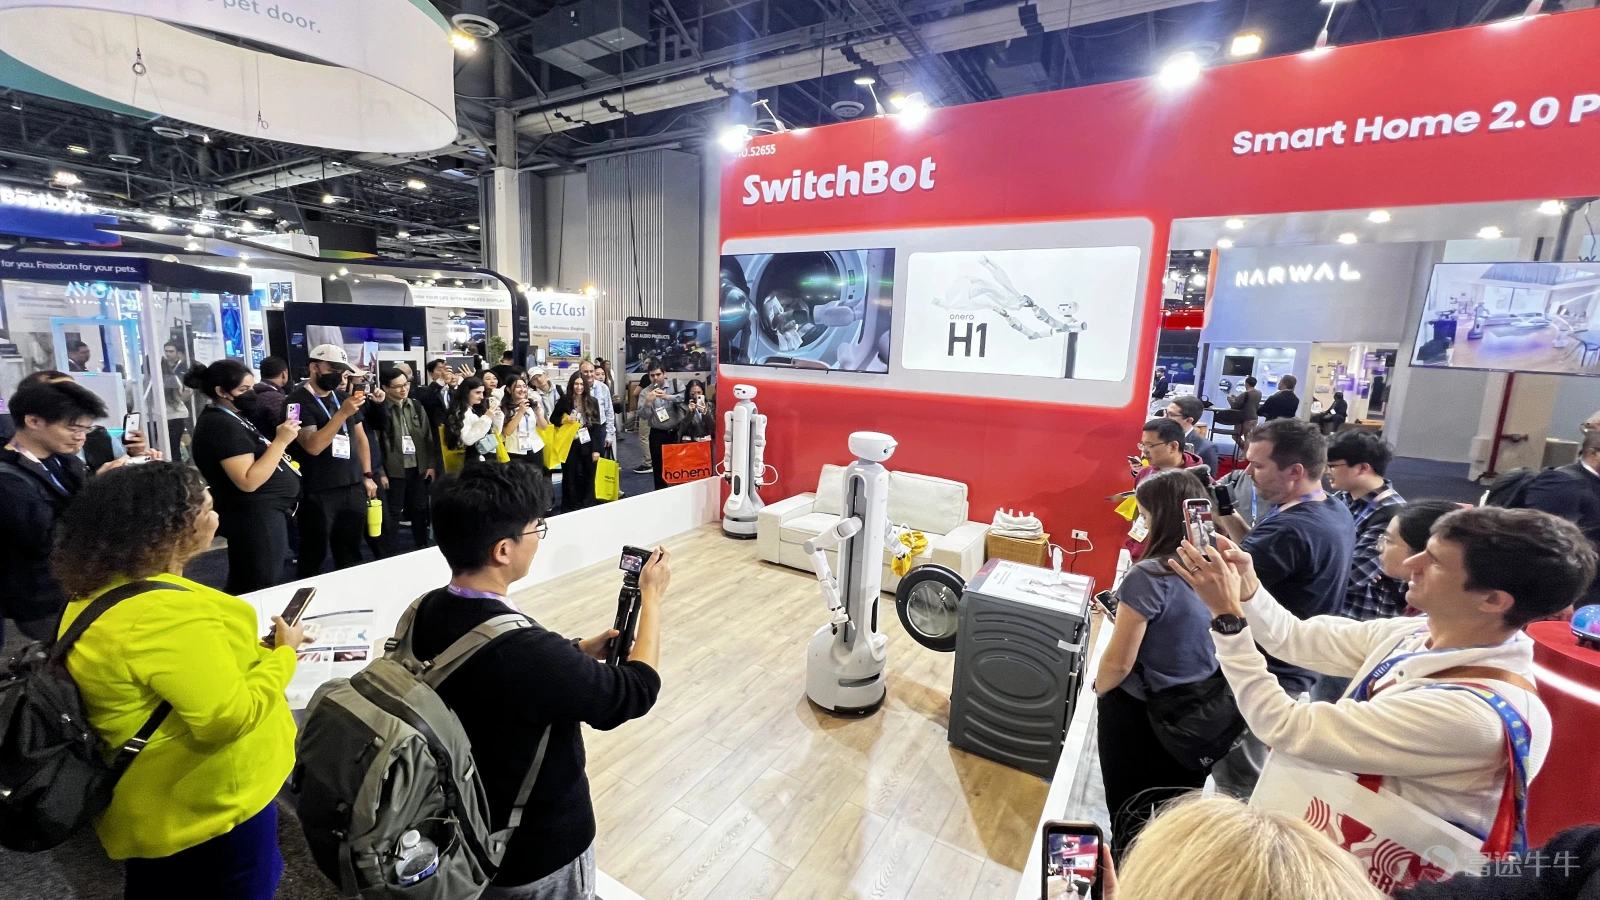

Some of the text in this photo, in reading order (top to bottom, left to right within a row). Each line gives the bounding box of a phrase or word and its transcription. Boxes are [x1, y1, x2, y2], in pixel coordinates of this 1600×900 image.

[267, 5, 322, 33] door.
[1232, 94, 1600, 155] Smart Home 2.0 P
[737, 144, 776, 158] O.52655
[742, 157, 936, 205] SwitchBot
[17, 262, 35, 270] you.
[37, 261, 78, 270] Freedom
[94, 265, 113, 273] your
[115, 265, 137, 274] pets.
[1235, 262, 1361, 287] NARWAL
[550, 302, 586, 317] EZCast
[949, 313, 975, 321] onero
[947, 322, 988, 358] H1
[664, 467, 711, 480] hohem
